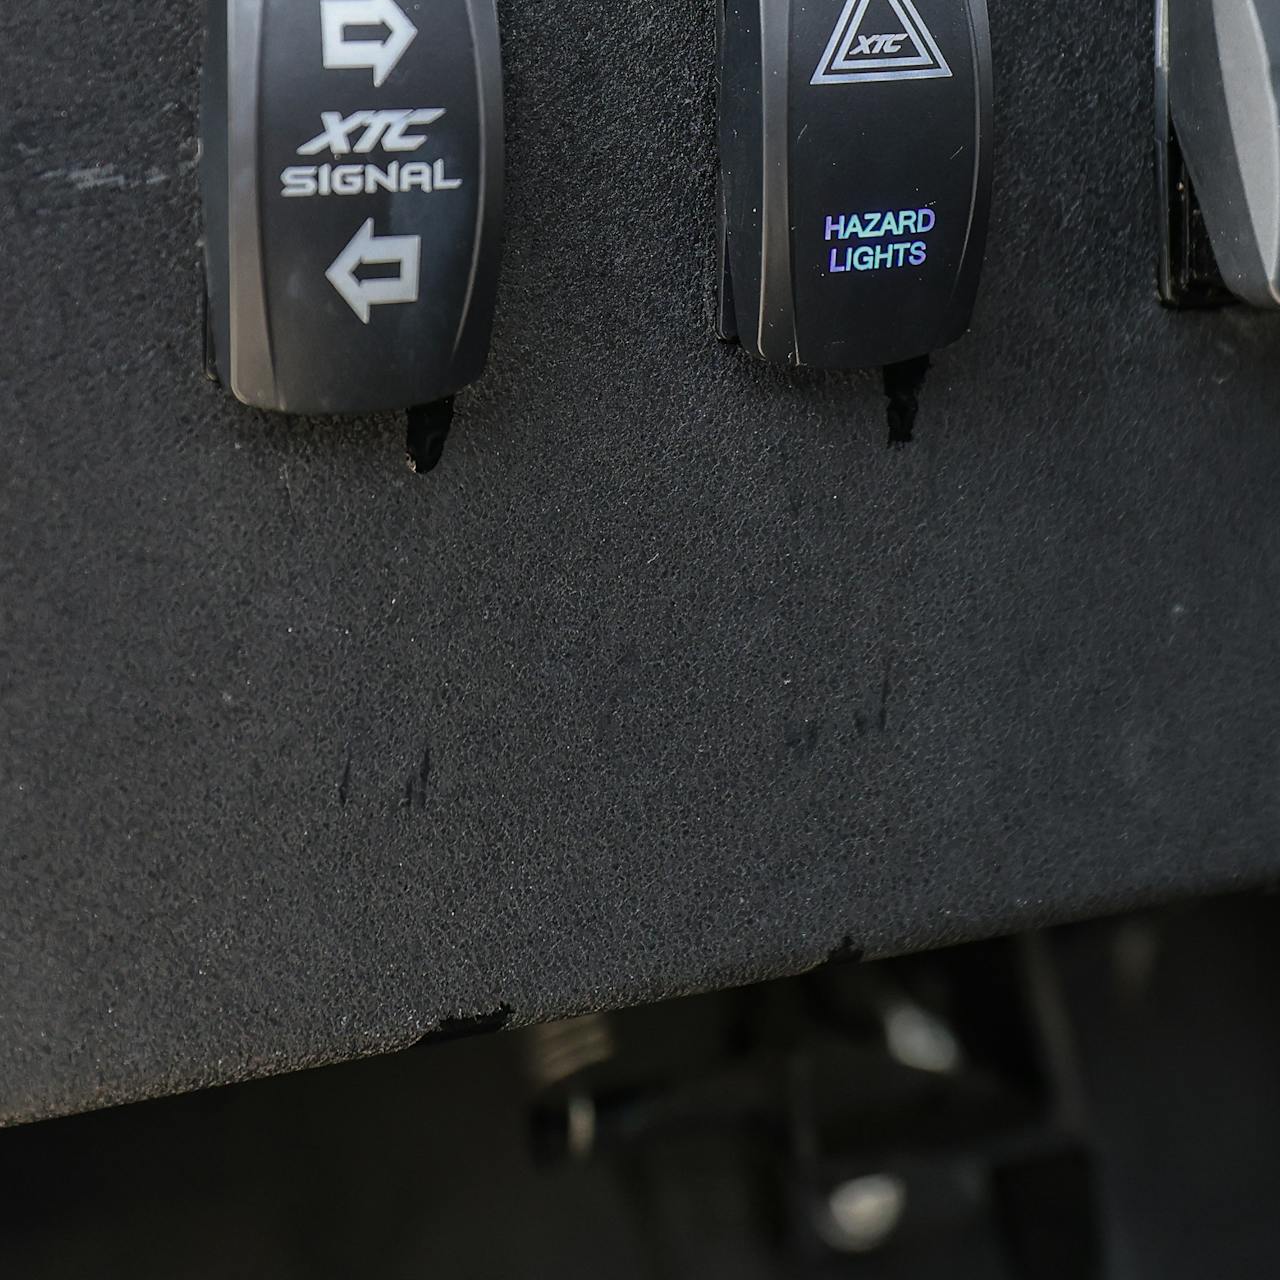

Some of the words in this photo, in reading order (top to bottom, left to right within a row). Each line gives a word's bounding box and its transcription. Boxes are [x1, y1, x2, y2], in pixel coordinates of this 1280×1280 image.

[848, 32, 908, 56] XTC
[297, 107, 446, 155] XTC
[281, 158, 463, 197] SIGNAL
[823, 207, 936, 241] HAZARD
[828, 241, 928, 273] LIGHTS
